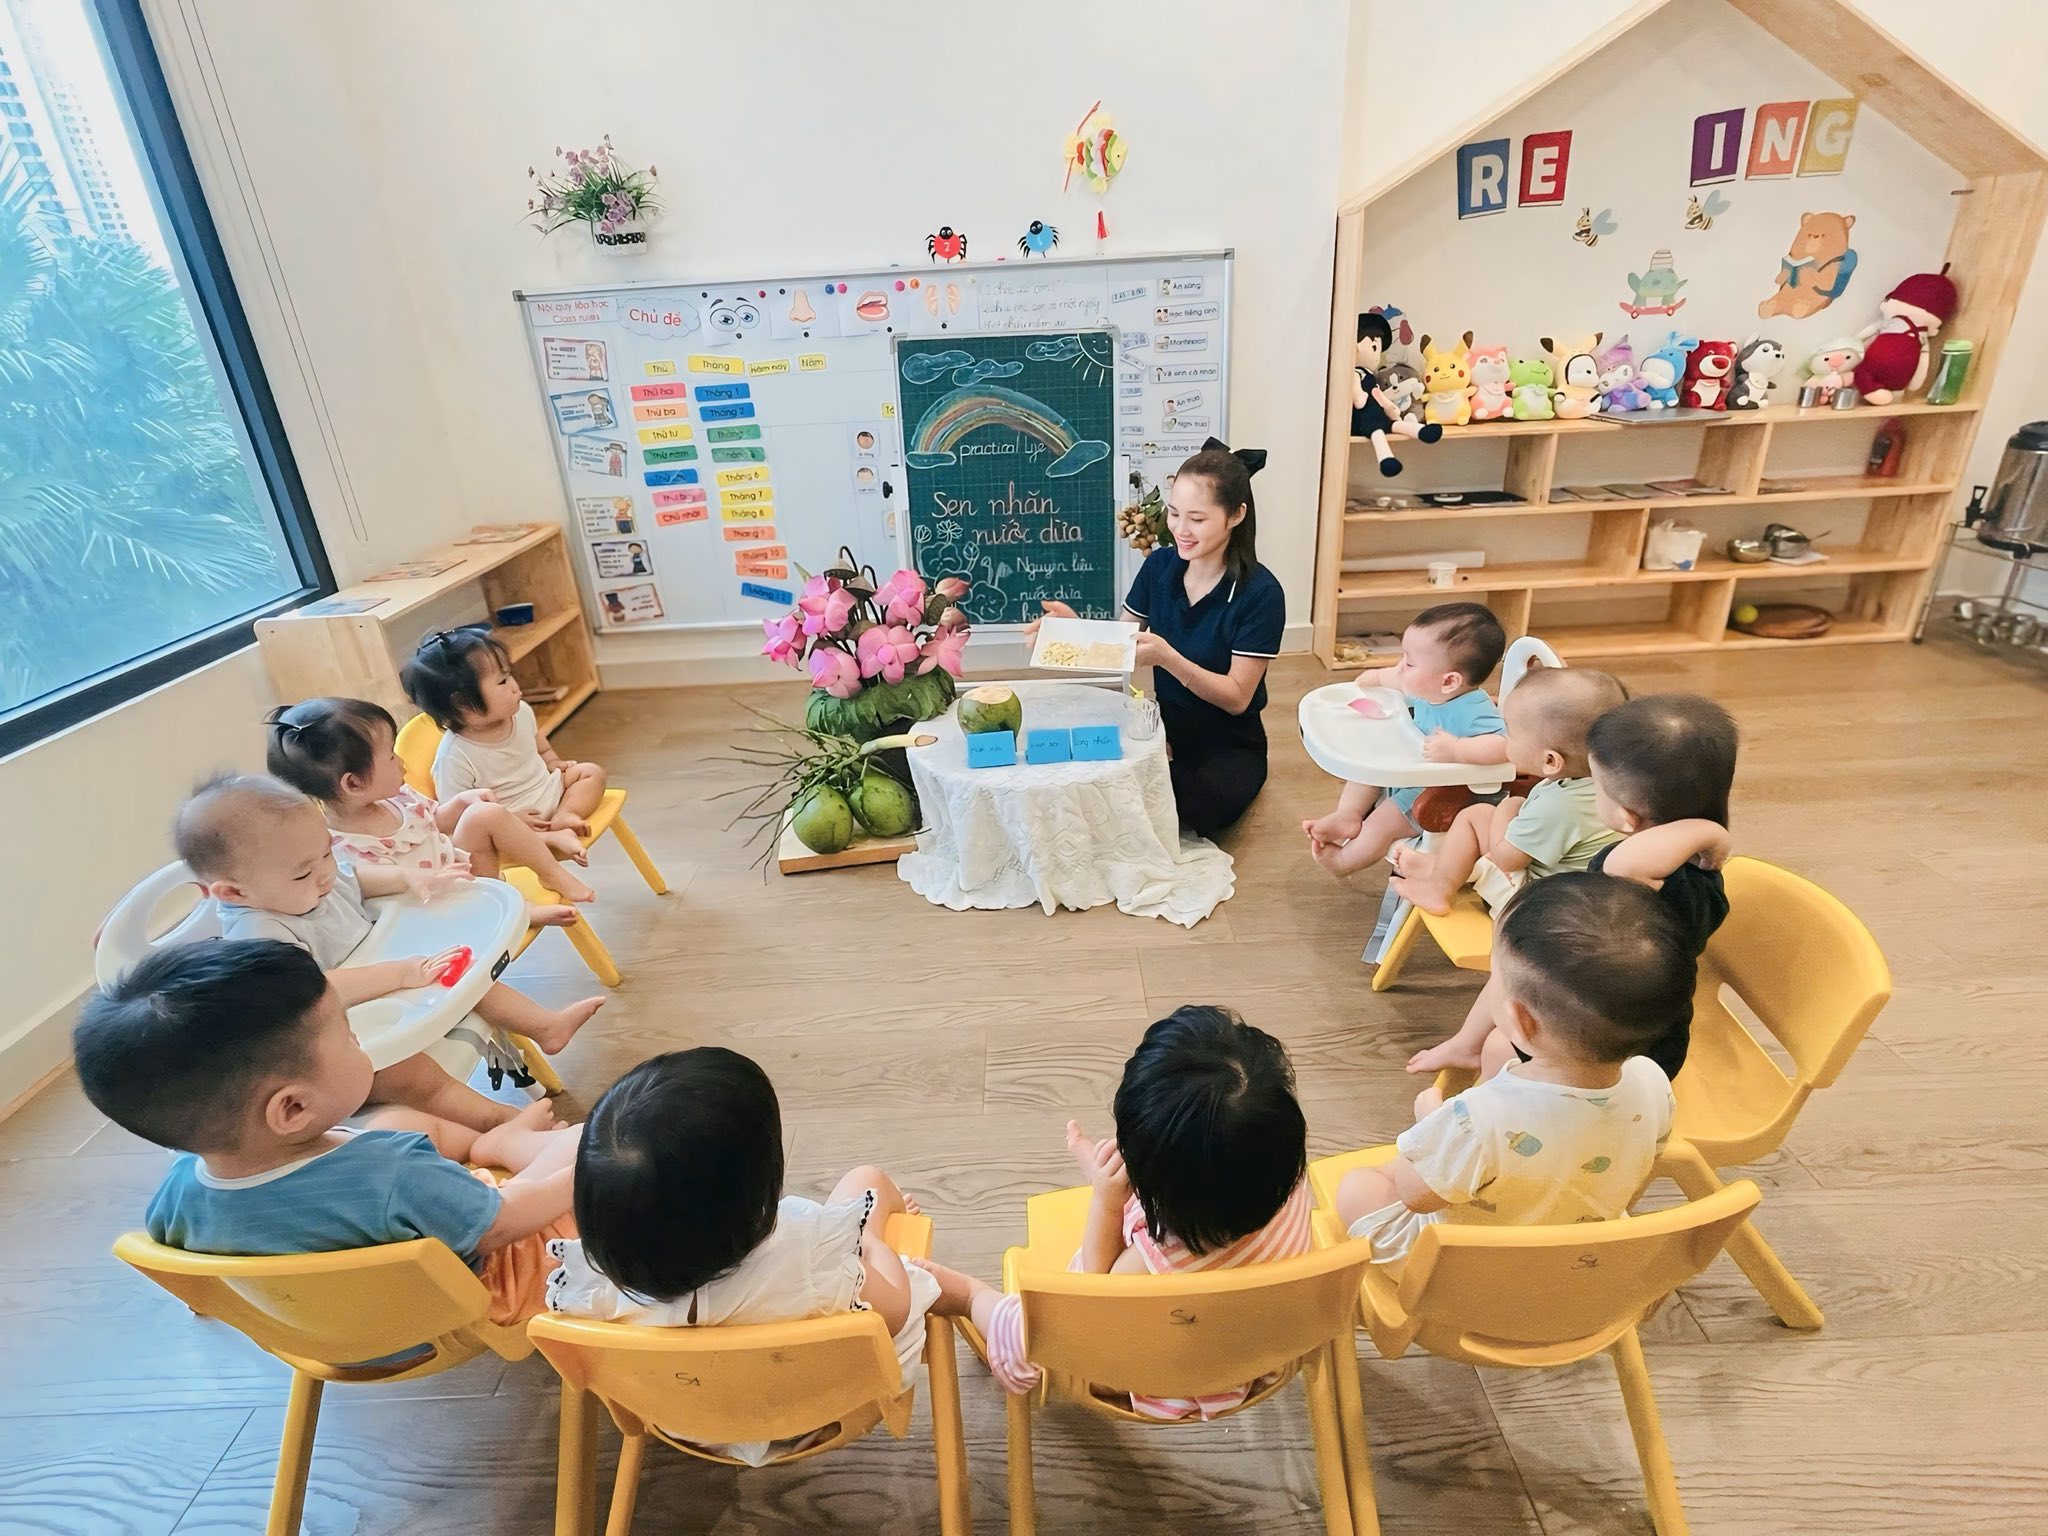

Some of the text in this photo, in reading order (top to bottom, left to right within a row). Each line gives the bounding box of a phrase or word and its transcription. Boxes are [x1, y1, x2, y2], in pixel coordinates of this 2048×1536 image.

[943, 241, 951, 252] 2
[552, 314, 577, 323] Class
[630, 309, 658, 323] Chủ
[703, 360, 730, 372] Tháng
[705, 388, 732, 399] Tháng
[664, 408, 677, 416] ba
[960, 430, 1020, 466] practical
[730, 492, 756, 501] Tháng
[931, 491, 978, 518] Sen
